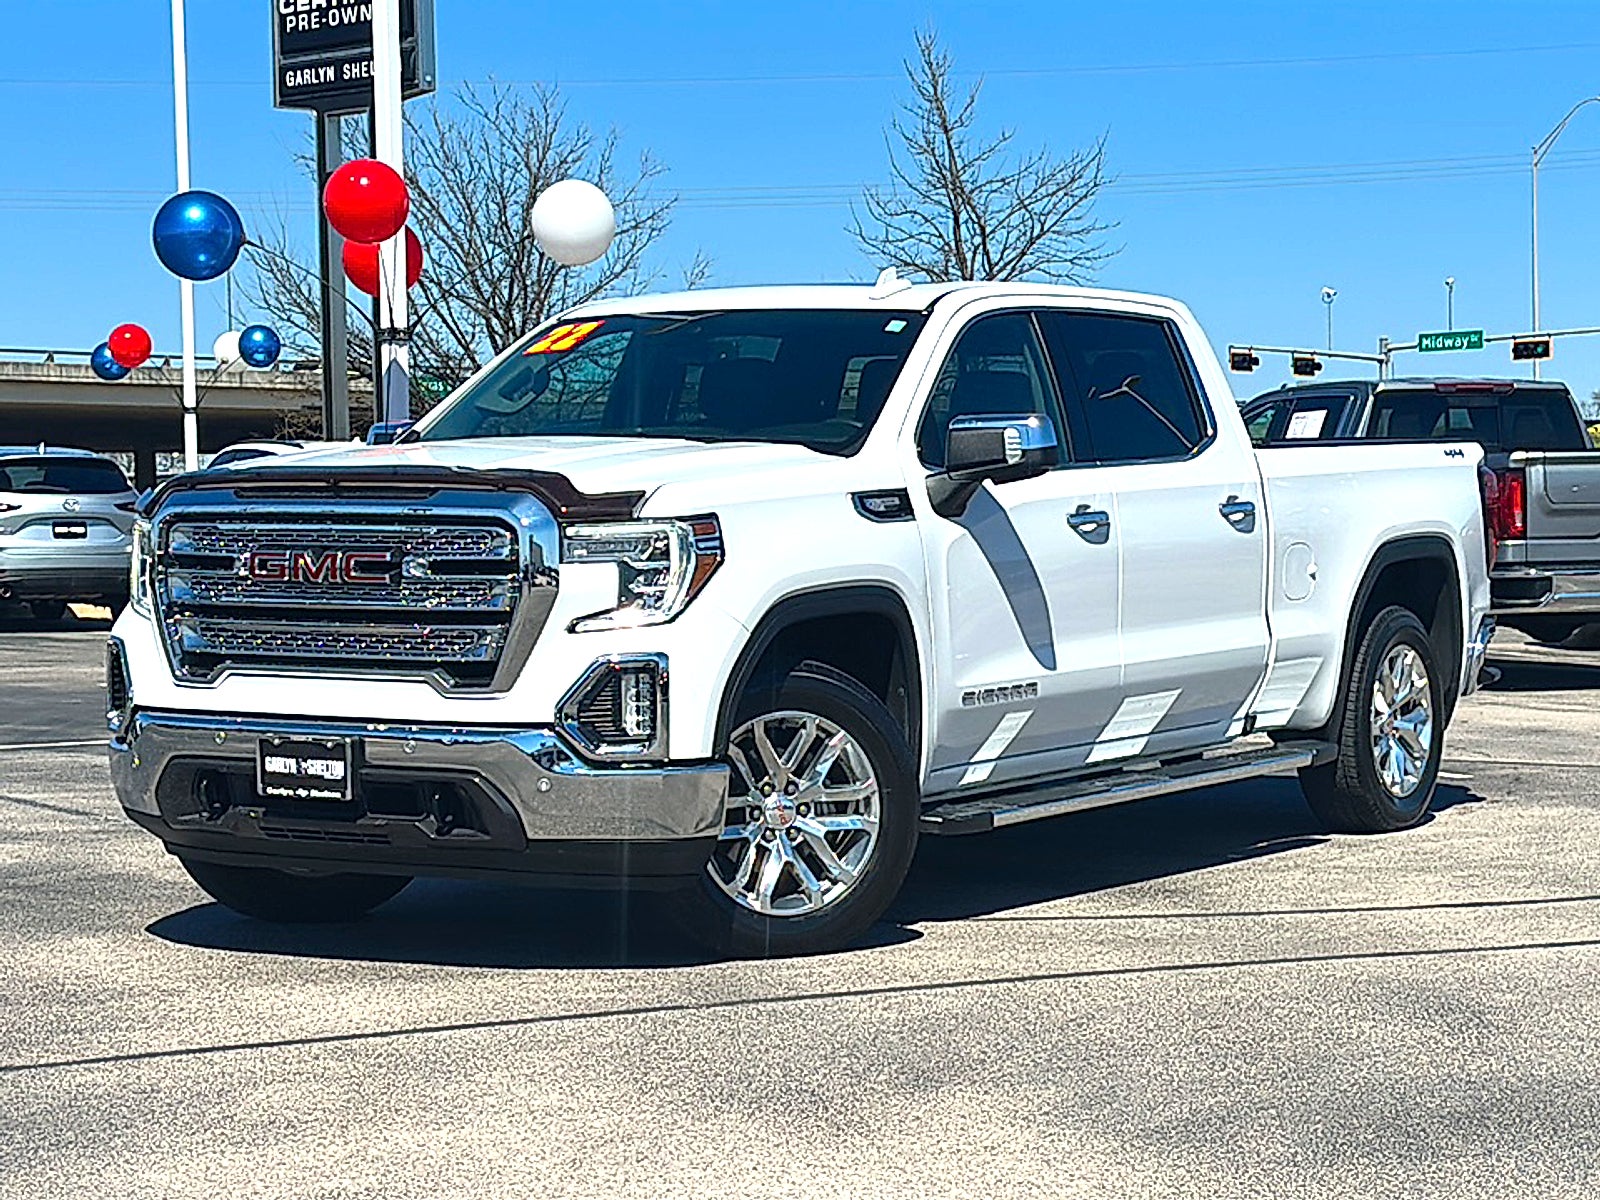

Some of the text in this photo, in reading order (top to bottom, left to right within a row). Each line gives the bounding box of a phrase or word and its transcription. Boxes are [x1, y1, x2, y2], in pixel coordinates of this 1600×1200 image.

[285, 65, 335, 87] GARLYN
[1421, 335, 1469, 351] Midway
[249, 551, 391, 583] GMC
